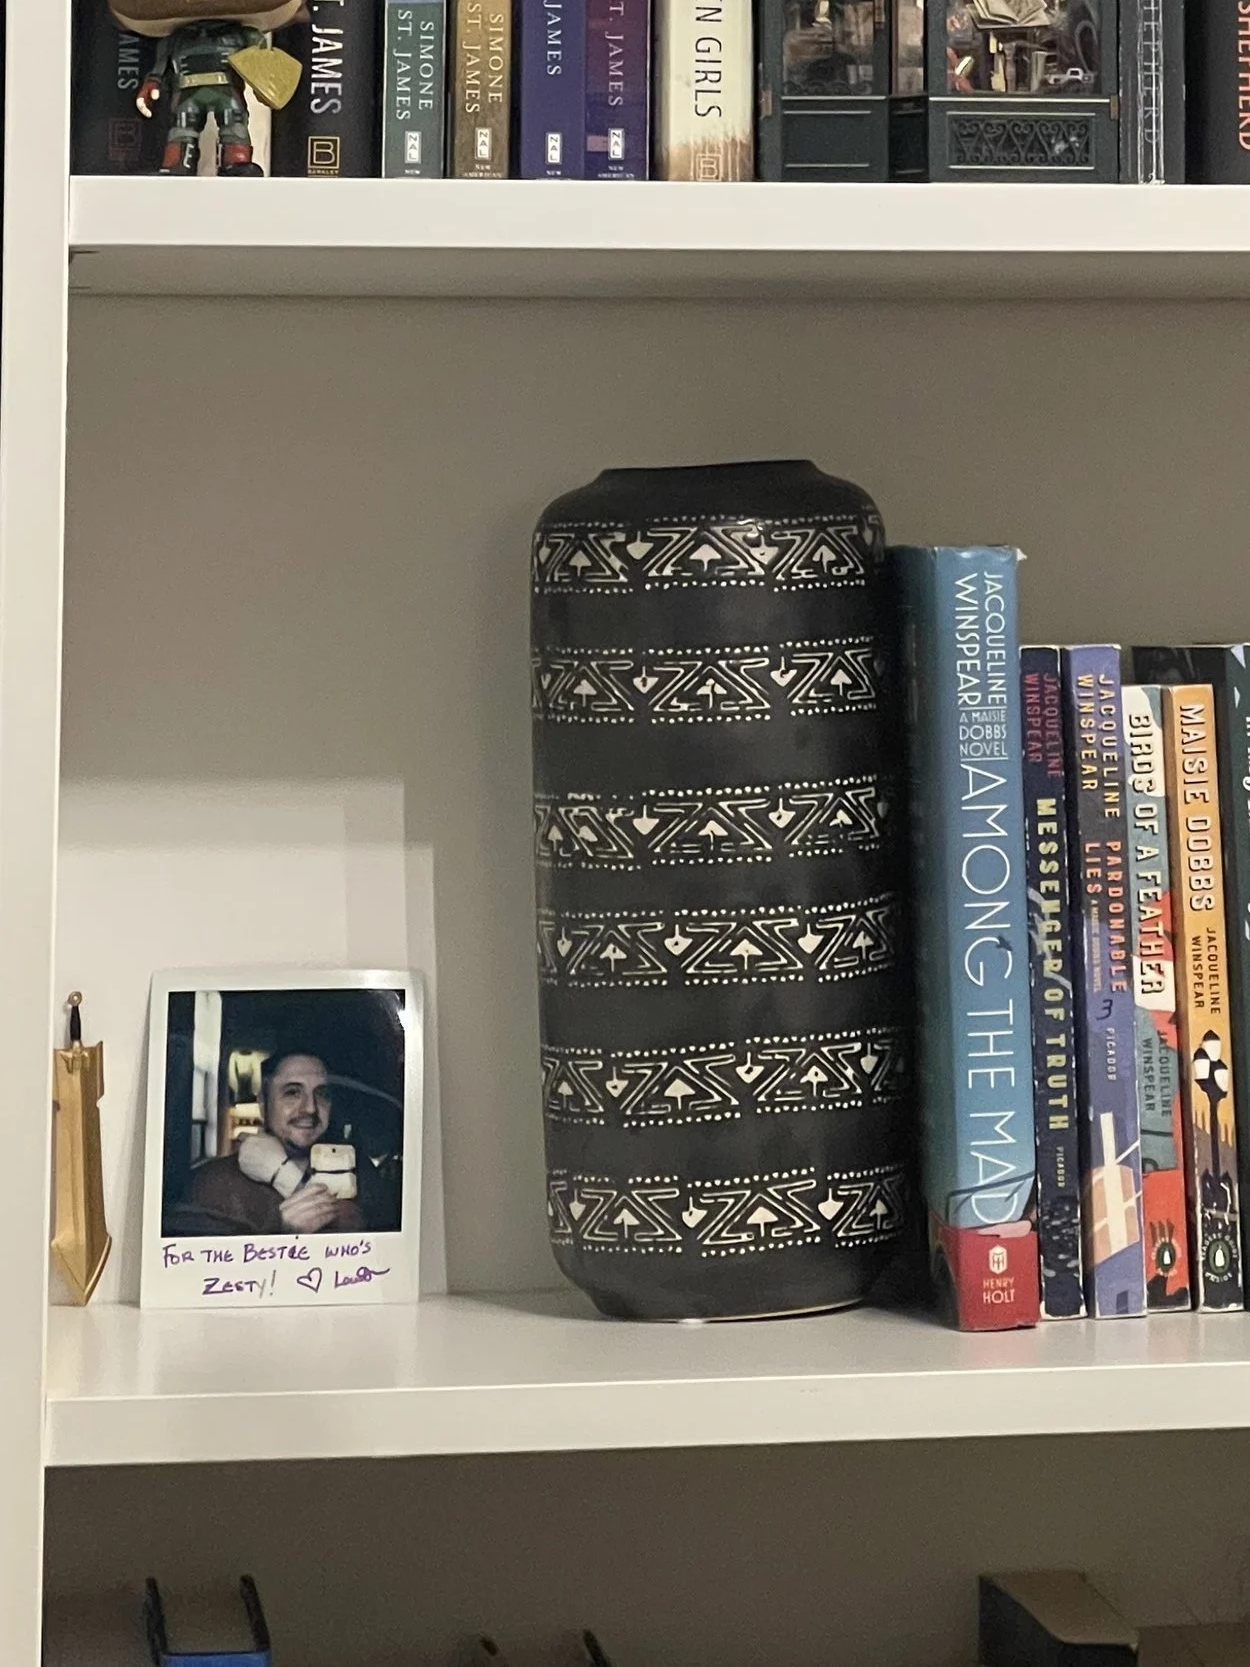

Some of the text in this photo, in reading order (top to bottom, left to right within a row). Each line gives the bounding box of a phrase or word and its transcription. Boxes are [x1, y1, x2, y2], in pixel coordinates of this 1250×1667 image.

[694, 36, 723, 119] GIRLS
[955, 572, 981, 706] WINSPEAR
[984, 571, 1006, 708] JACQUELINE
[1127, 712, 1166, 994] BIRDS OF A FEATHER
[1179, 704, 1216, 913] MAISIE DOBBS
[961, 764, 1018, 1224] AMONG THE MAD
[201, 1249, 233, 1263] THE
